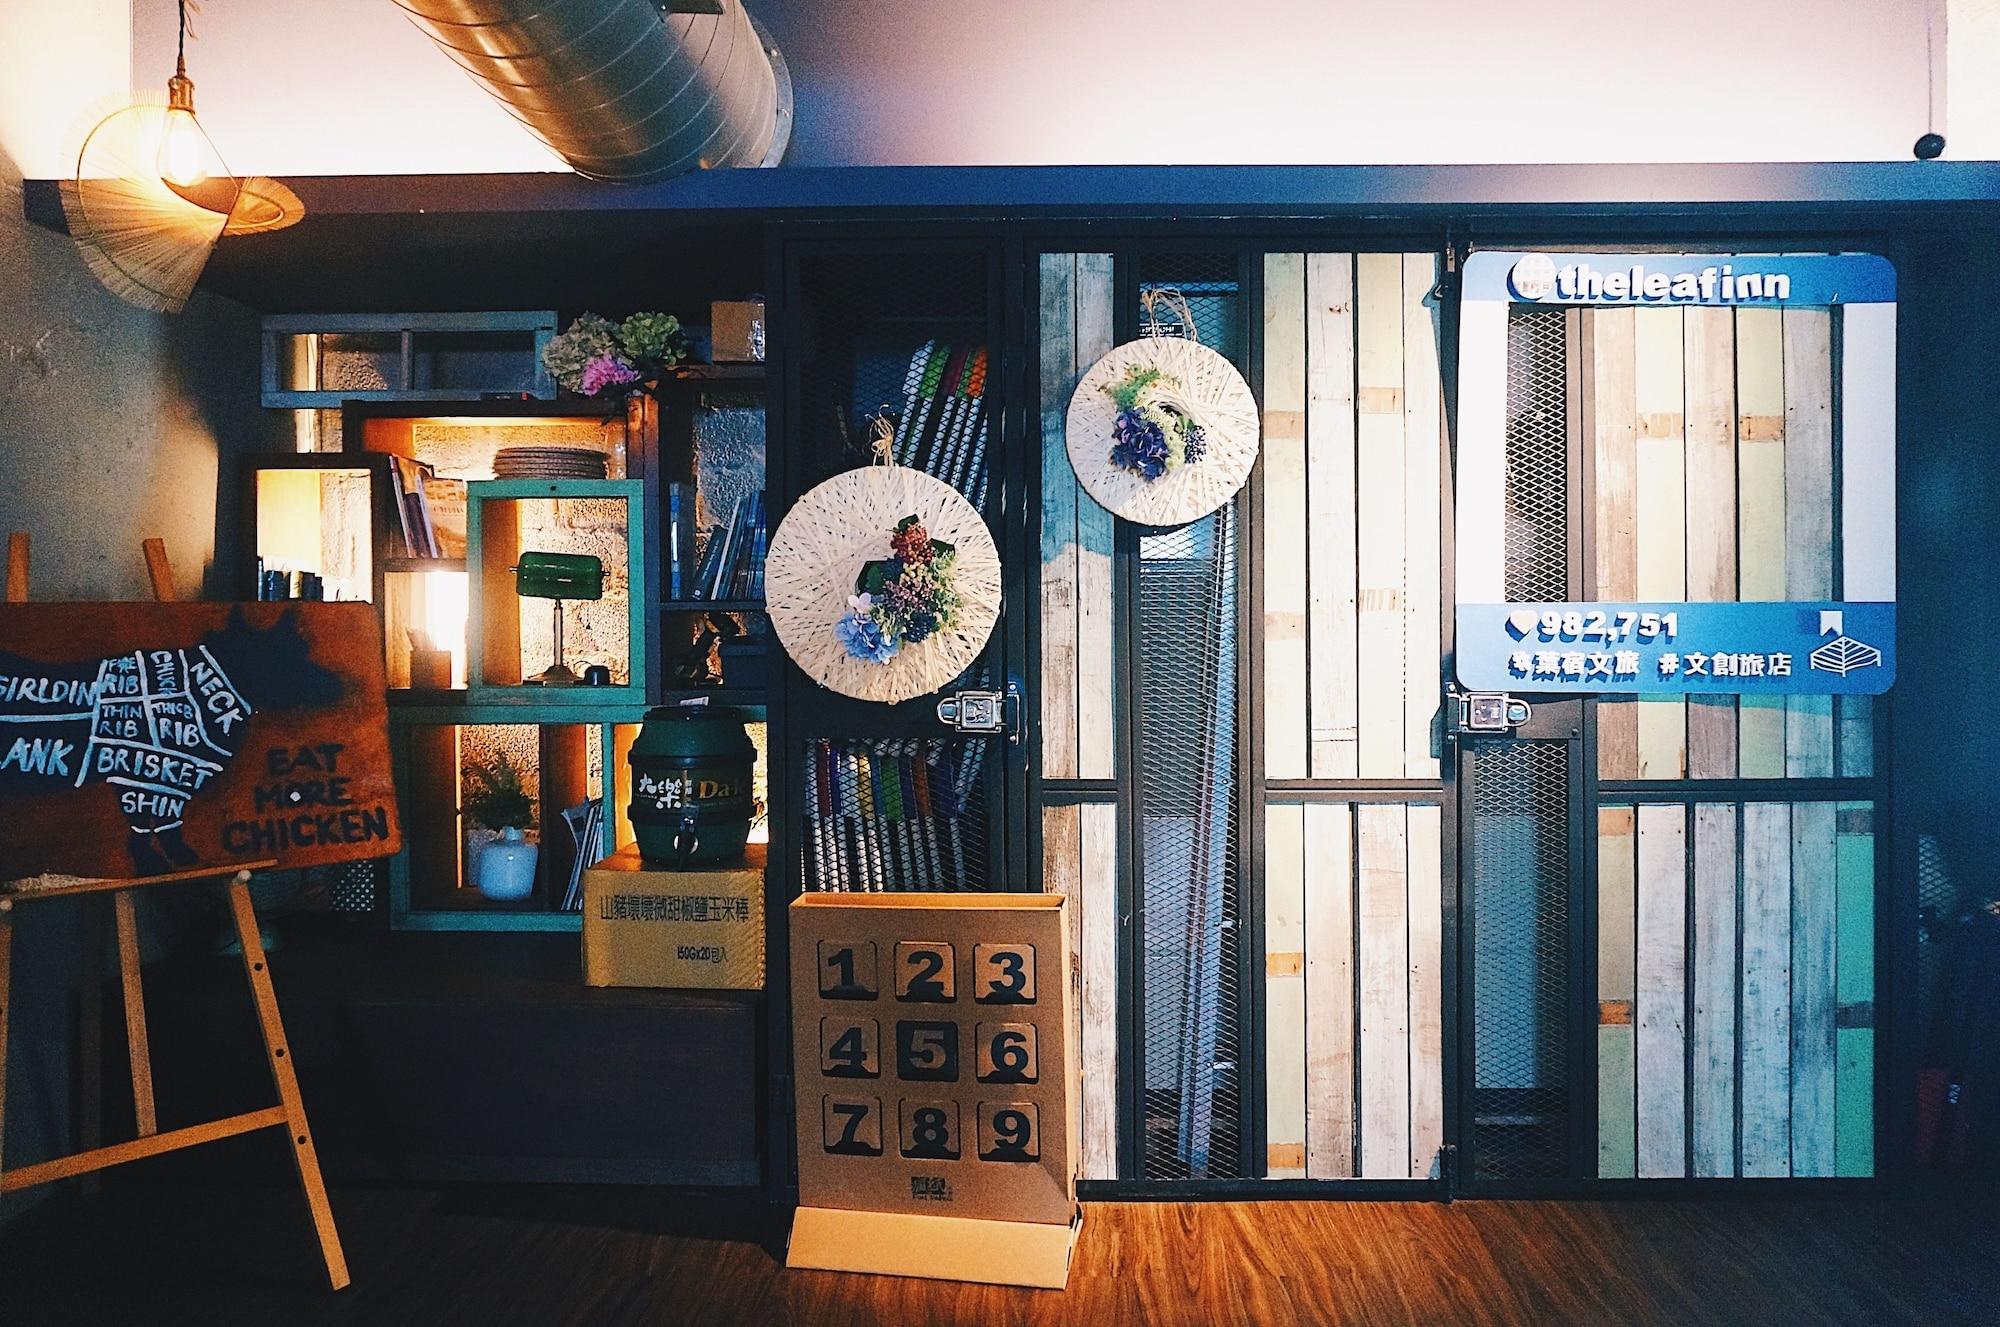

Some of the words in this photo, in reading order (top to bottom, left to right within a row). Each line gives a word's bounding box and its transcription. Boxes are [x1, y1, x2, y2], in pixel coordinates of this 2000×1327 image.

[1556, 263, 1791, 300] theleafinn
[1540, 611, 1679, 643] 982,751
[102, 673, 139, 694] RIB
[150, 651, 178, 695] CHUCK
[102, 704, 143, 720] THIN
[190, 661, 244, 735] NECK
[100, 720, 139, 738] RIB
[160, 718, 200, 747] RIB
[97, 747, 213, 789] BRISKET
[267, 742, 344, 775] EAT
[121, 791, 184, 818] SHIN
[254, 776, 353, 813] MORE
[222, 805, 388, 855] CHICKEN
[827, 948, 864, 993] 1
[907, 951, 945, 995] 2
[988, 952, 1026, 994] 3
[829, 1027, 867, 1070] 4
[909, 1030, 947, 1070] 5
[990, 1032, 1028, 1074] 6
[832, 1104, 869, 1146] 7
[913, 1108, 949, 1150] 8
[992, 1109, 1031, 1152] 9
